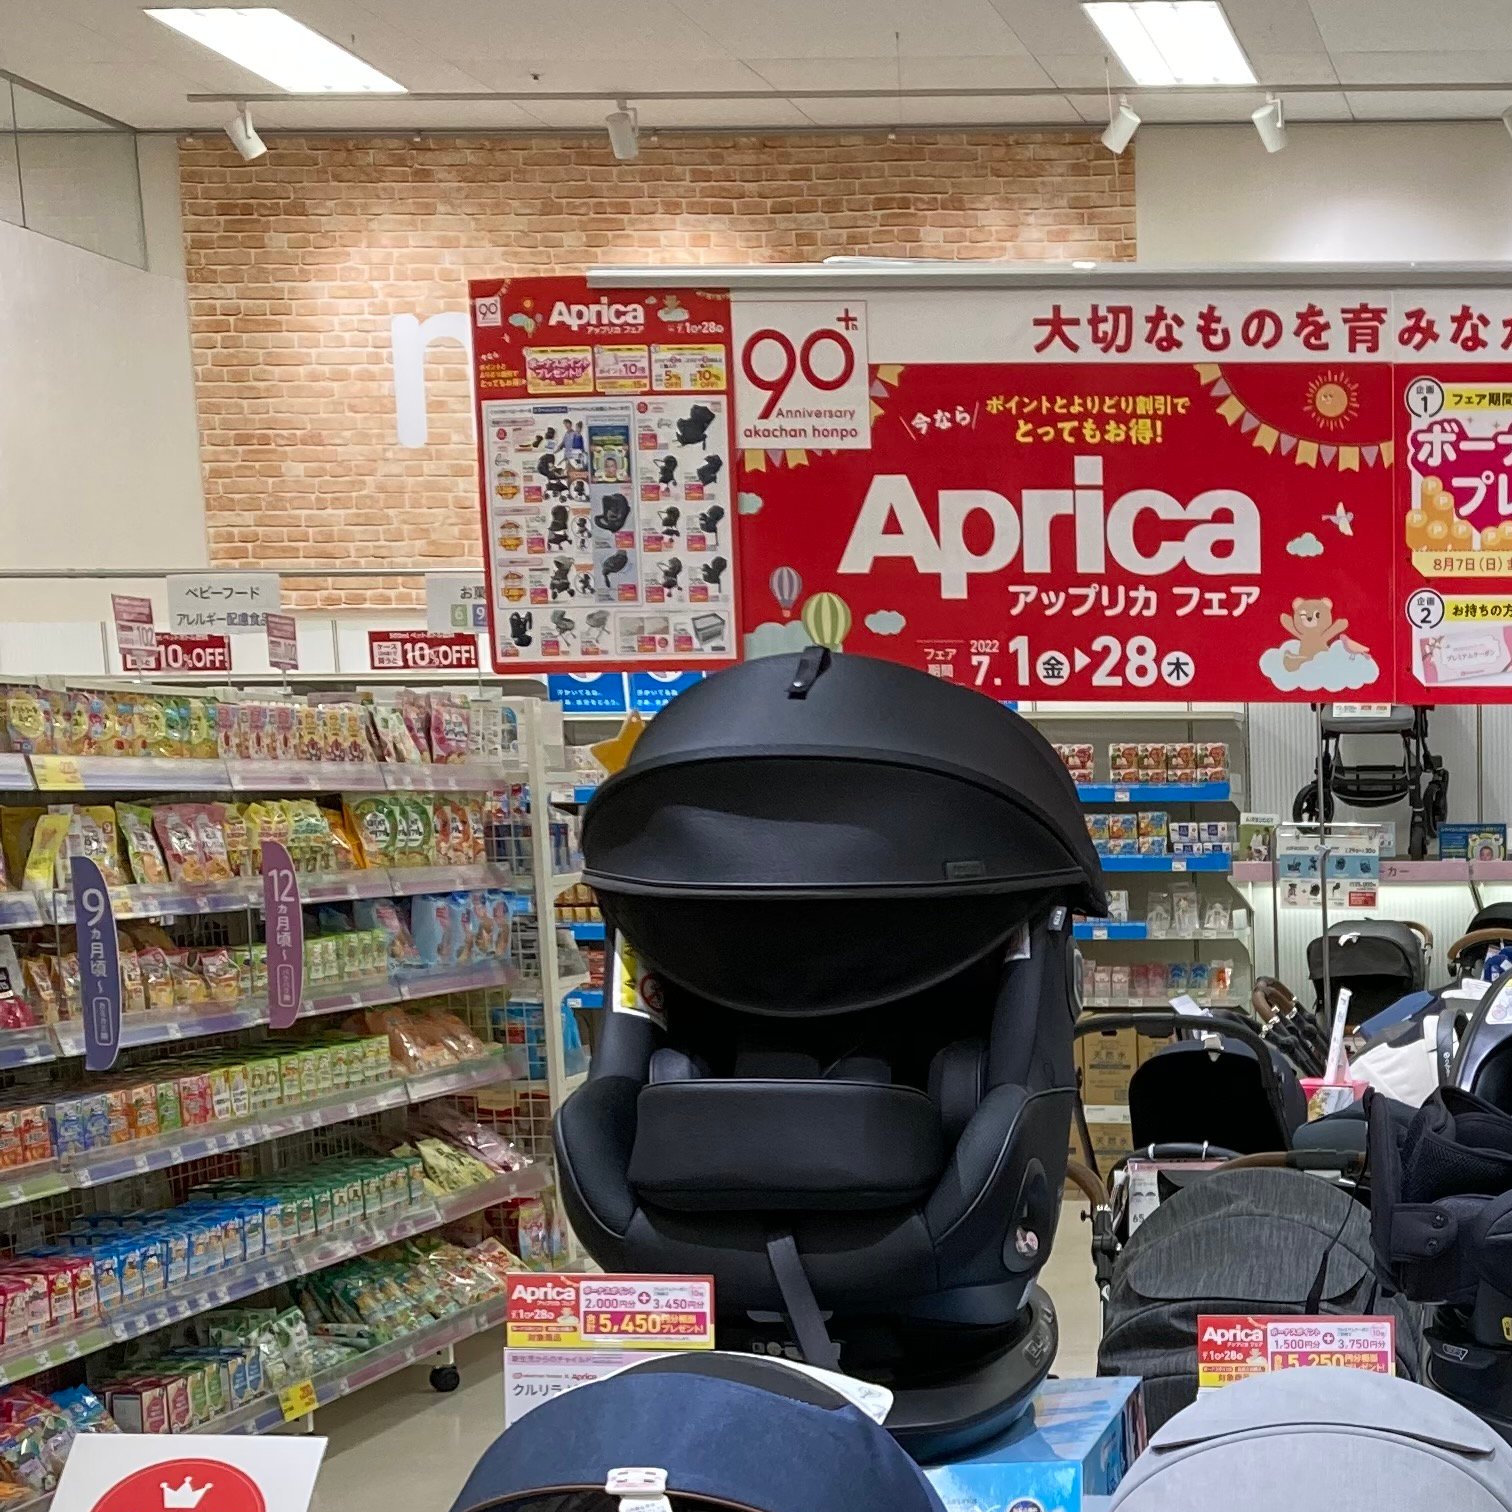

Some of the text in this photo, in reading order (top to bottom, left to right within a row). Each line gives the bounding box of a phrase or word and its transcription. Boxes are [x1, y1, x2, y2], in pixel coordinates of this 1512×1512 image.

[549, 296, 645, 330] Aprica
[775, 407, 857, 421] Anniversary
[985, 394, 1191, 415] ポイントとよりどり割引で
[911, 405, 972, 434] 今なら
[743, 424, 859, 440] akachan honpo
[1015, 418, 1163, 445] とってもお得!
[837, 455, 1262, 600] Aprica
[185, 586, 261, 600] ベビーフード
[1007, 584, 1261, 617] アップリカ フェア
[970, 640, 1000, 653] 2022
[511, 1282, 577, 1302] Aprica
[1202, 1323, 1264, 1345] Aprica
